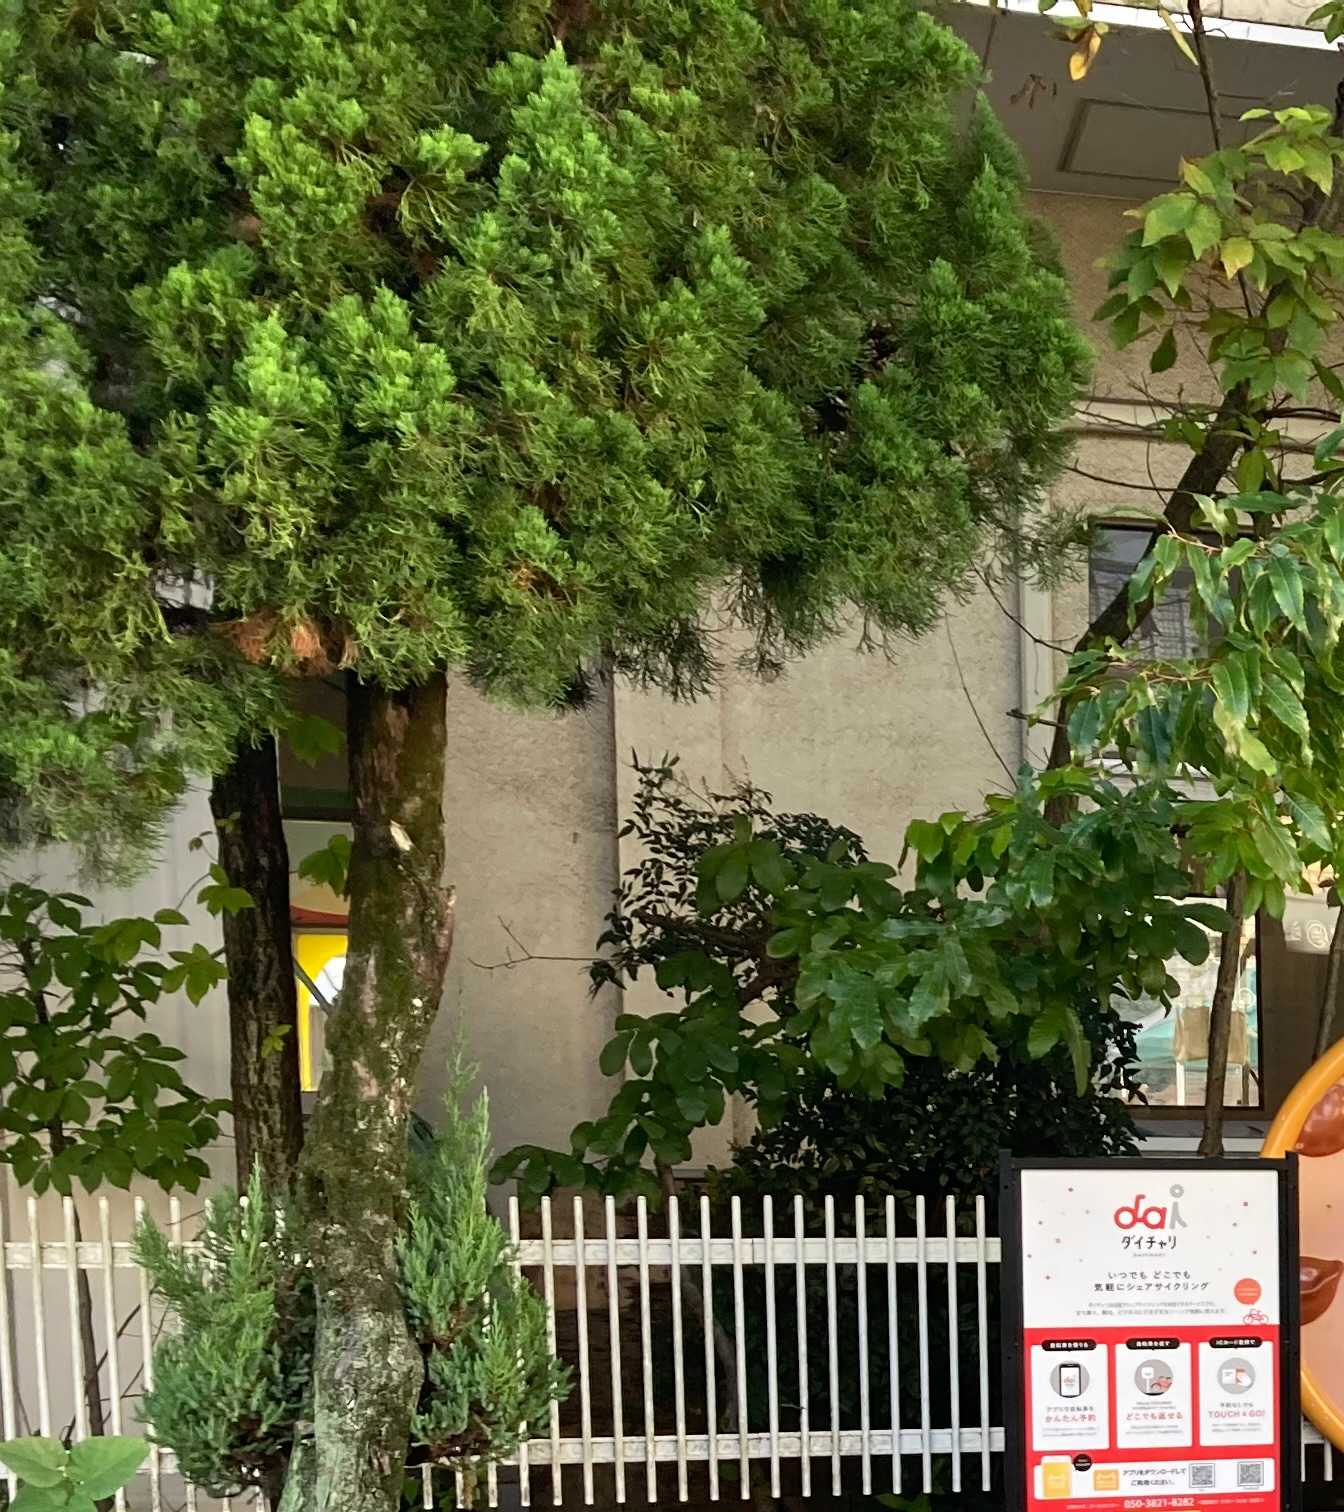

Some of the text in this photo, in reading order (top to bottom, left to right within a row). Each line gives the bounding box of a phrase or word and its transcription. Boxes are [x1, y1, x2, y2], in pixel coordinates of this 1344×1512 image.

[1114, 1184, 1188, 1230] dai
[1121, 1234, 1178, 1250] ダイチャリ
[1108, 1269, 1192, 1280] いつでも どこでも
[1094, 1281, 1209, 1292] 気軽にシェアサイクリング
[1125, 1411, 1184, 1422] どこでも返せる
[1208, 1410, 1240, 1418] TOUCH
